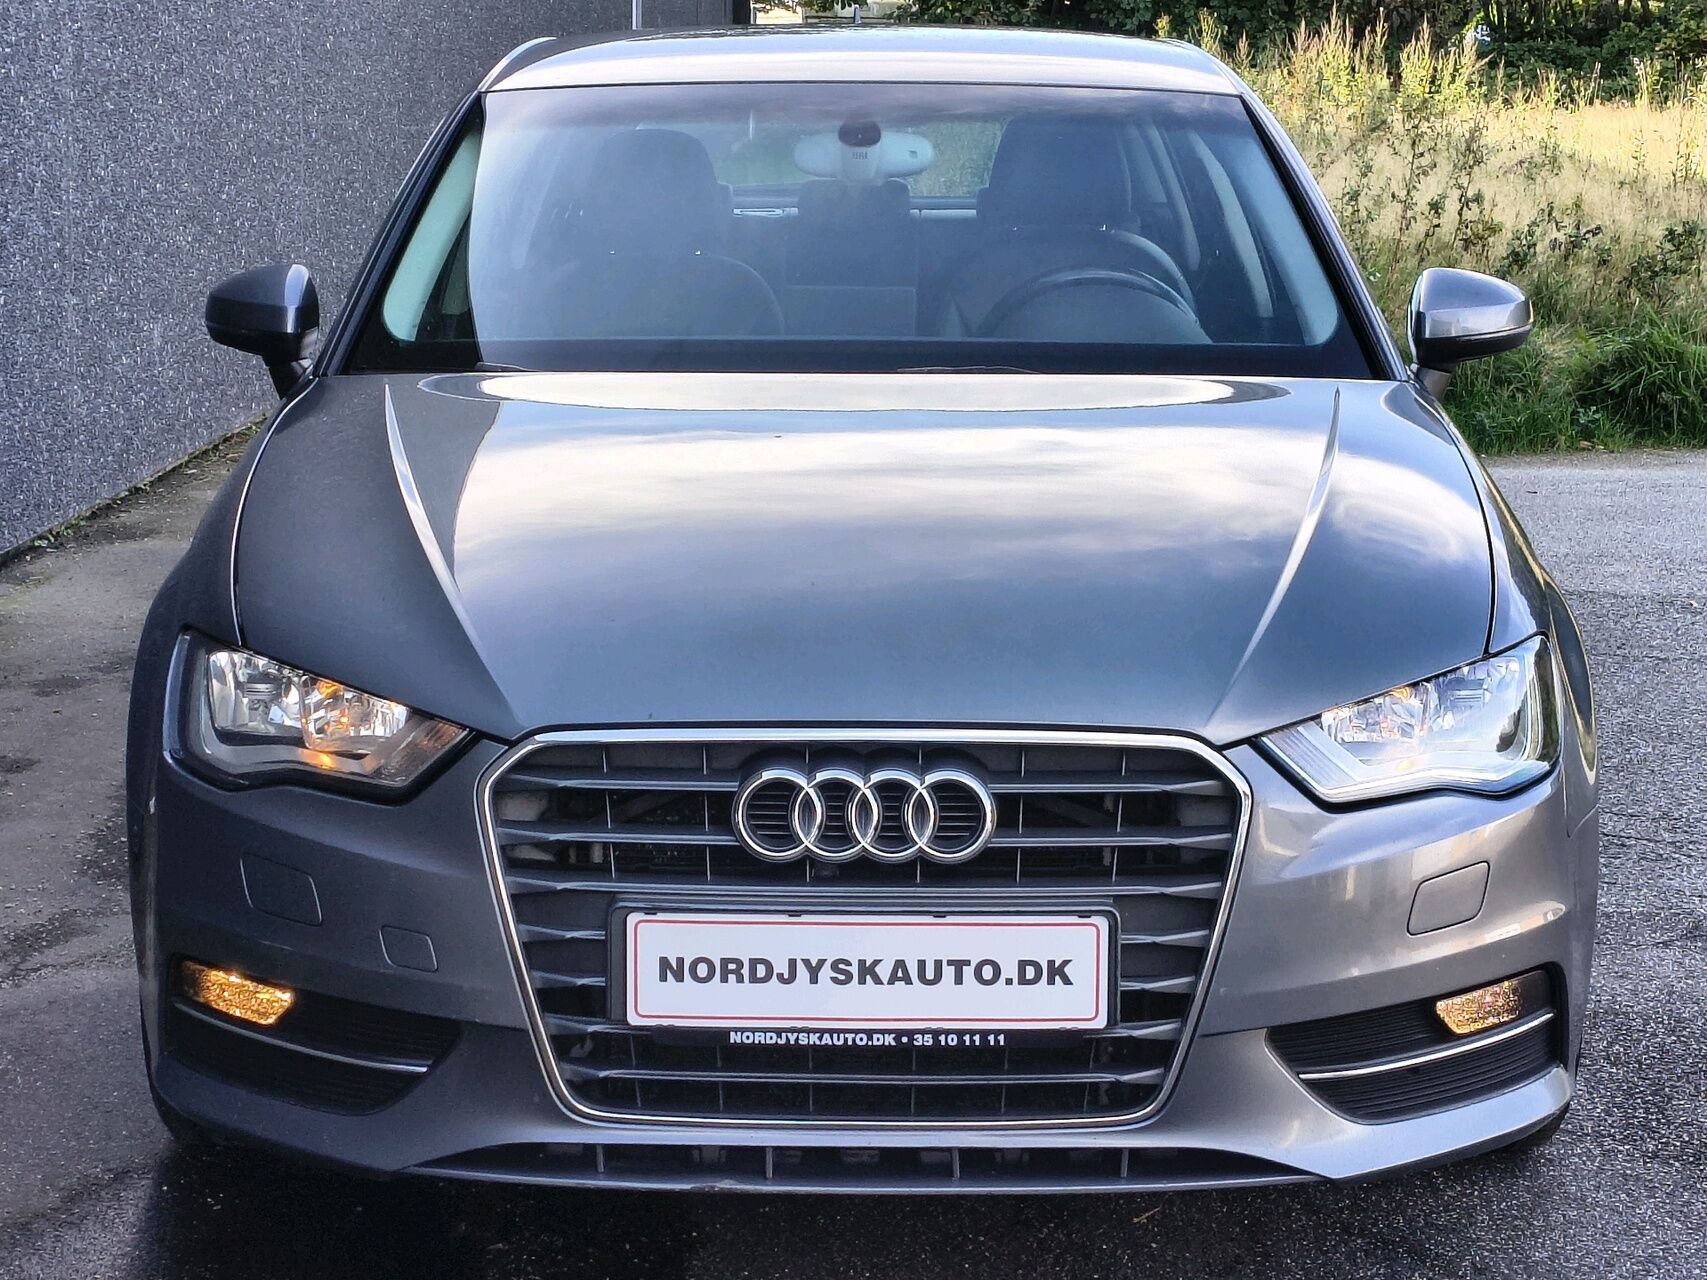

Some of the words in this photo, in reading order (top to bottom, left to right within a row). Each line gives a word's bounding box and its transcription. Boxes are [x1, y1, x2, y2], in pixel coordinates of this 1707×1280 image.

[658, 956, 1074, 986] NORDJYSKAUTO.DK
[729, 1031, 897, 1046] NORDJYSKAUTO.DK
[913, 1033, 934, 1046] 35
[938, 1033, 958, 1046] 10
[963, 1033, 981, 1046] 11
[987, 1033, 1005, 1046] 11
